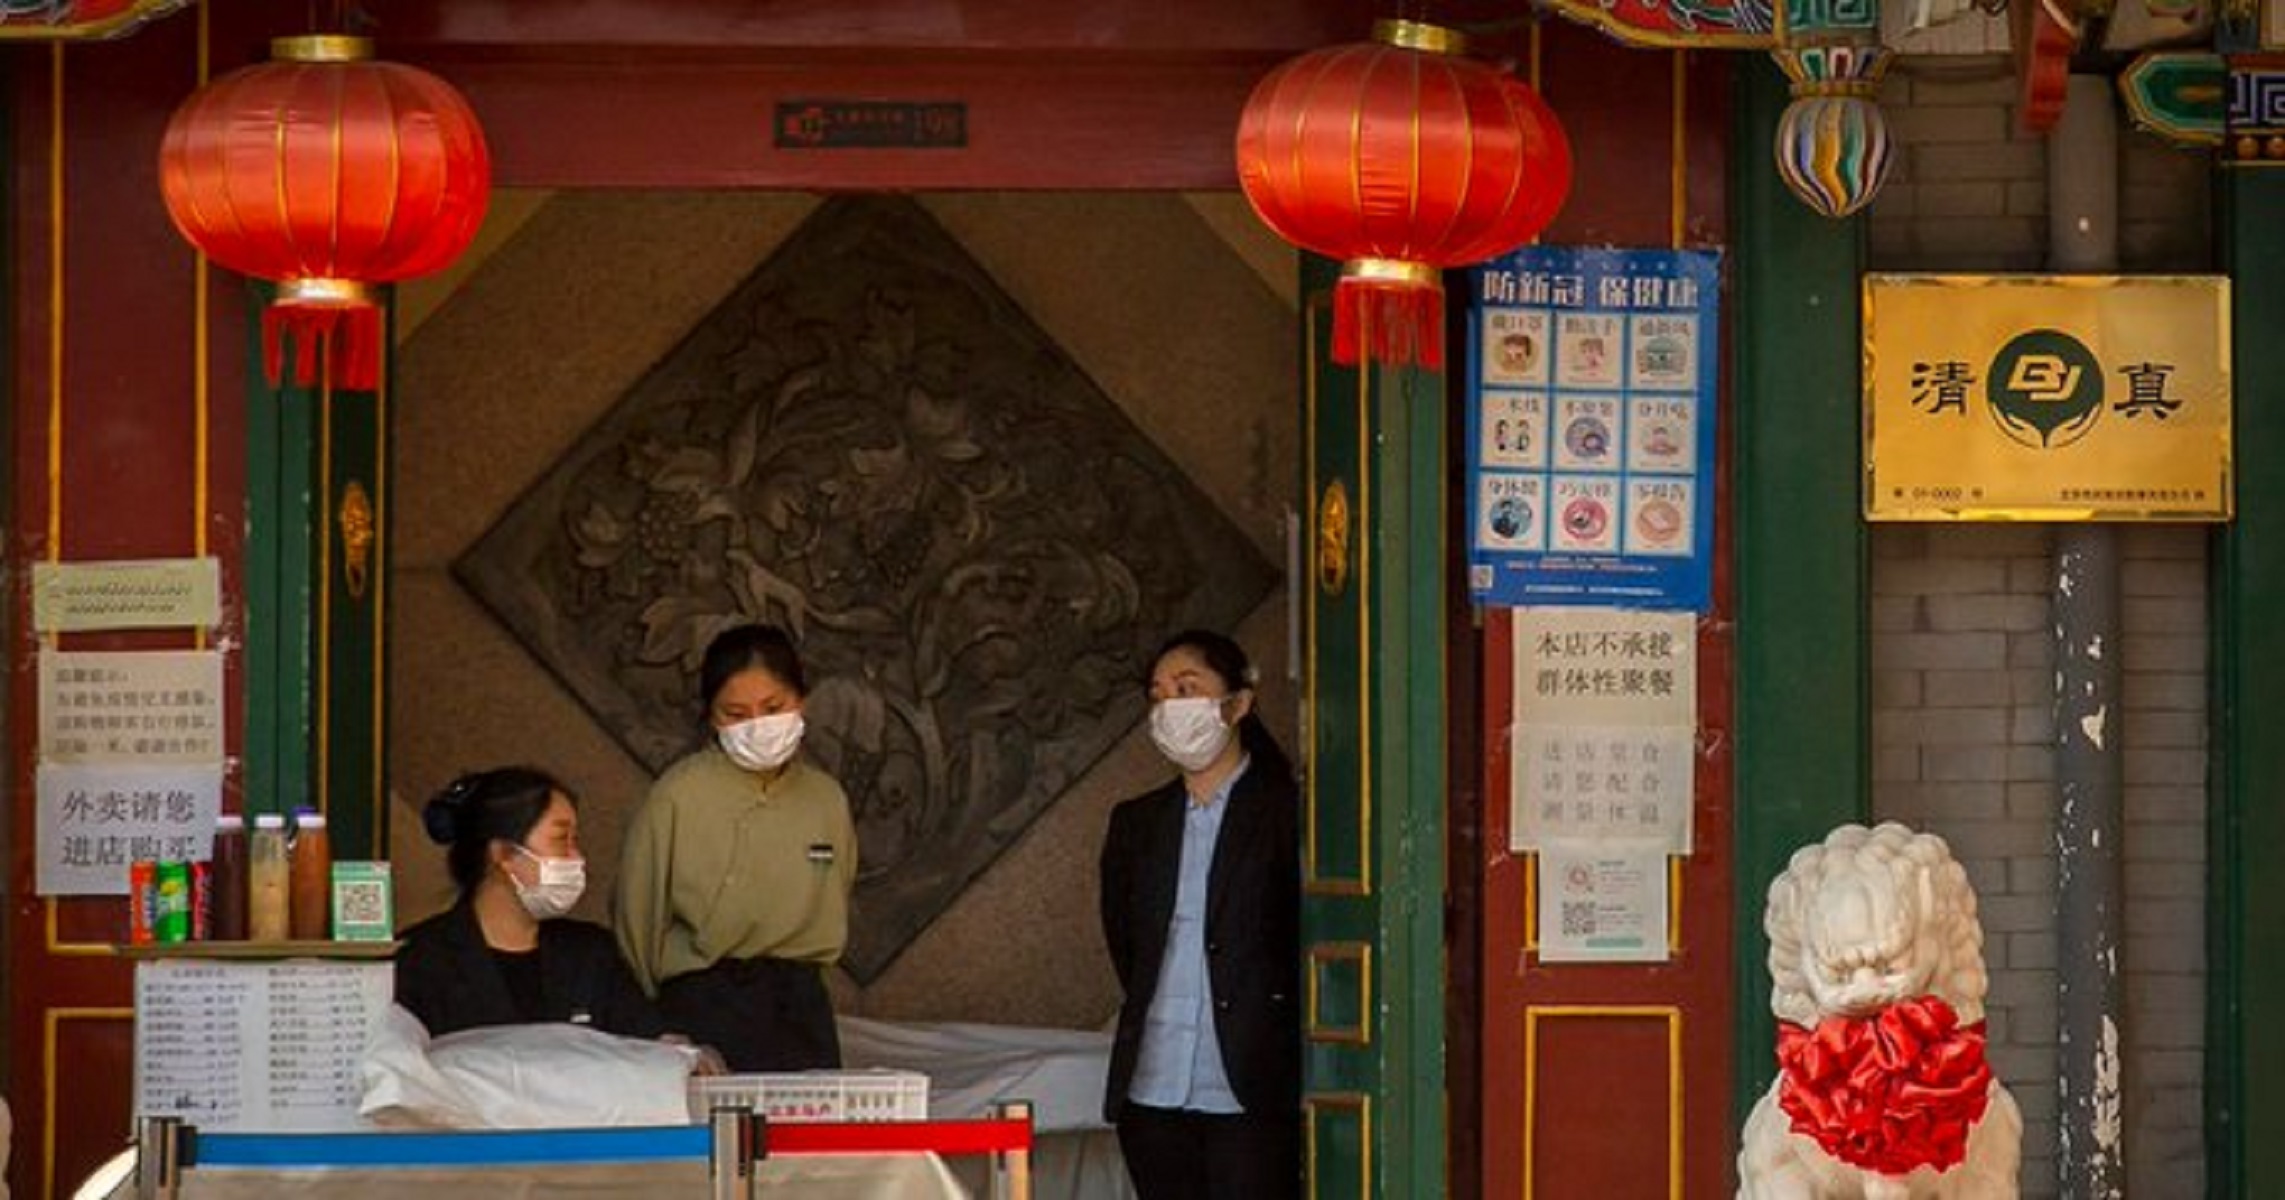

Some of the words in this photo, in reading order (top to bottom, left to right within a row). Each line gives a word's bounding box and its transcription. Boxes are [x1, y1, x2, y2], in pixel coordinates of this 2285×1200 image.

[1483, 270, 1584, 305] 防新冠
[1600, 276, 1699, 308] 保健康
[1911, 361, 1977, 416] 清
[2114, 361, 2182, 420] 真
[1535, 630, 1674, 660] 本店不承接
[1535, 667, 1675, 697] 群体性聚餐
[61, 789, 197, 824] 外卖请您
[61, 834, 197, 868] 进店购买
